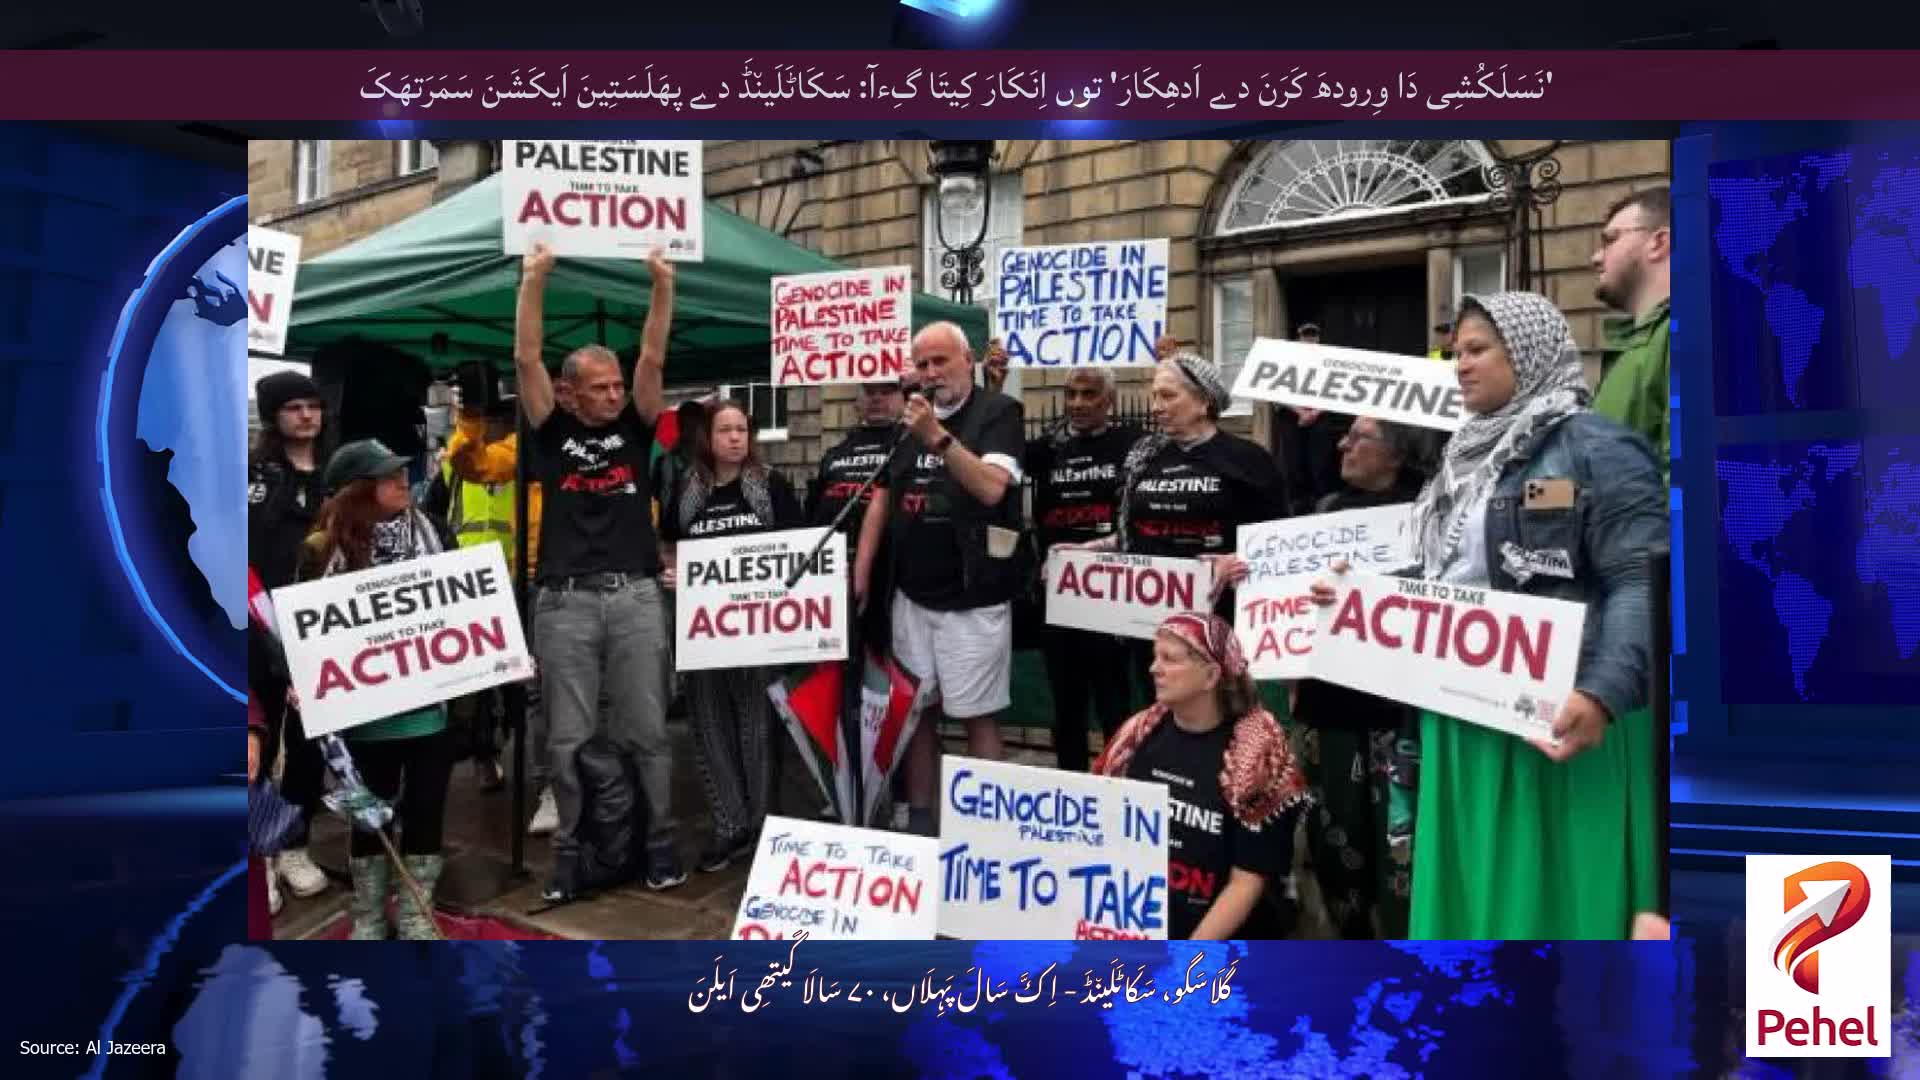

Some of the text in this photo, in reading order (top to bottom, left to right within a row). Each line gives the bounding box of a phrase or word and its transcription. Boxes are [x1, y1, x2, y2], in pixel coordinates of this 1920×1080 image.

[514, 141, 690, 178] PALESTINE
[517, 189, 687, 231] ACTION
[1002, 245, 1146, 274] GENOCIDE IN
[776, 274, 905, 306] GENOCIDE IN
[999, 265, 1166, 308] PALESTINE
[775, 298, 896, 333] PALESTINE
[998, 302, 1137, 331] TIME TO TAKE
[772, 327, 909, 356] TIME TO TAKE
[1006, 320, 1163, 366] ACTION
[780, 348, 905, 384] ACTION
[1249, 360, 1464, 419] PALESTINE
[1245, 524, 1369, 560] GENOCIDE
[355, 568, 433, 593] GENOCIDE IN
[686, 549, 835, 587] PALESTINE
[1056, 560, 1194, 611] ACTION
[293, 566, 498, 641] PALESTINE
[1397, 579, 1487, 606] TIME TO TAKE
[686, 595, 833, 640] ACTION
[1241, 593, 1313, 630] TIME
[399, 626, 415, 637] TO
[1329, 588, 1553, 682] ACTION
[314, 615, 508, 700] ACTION
[824, 841, 848, 860] TO
[863, 845, 914, 872] TAKE
[1008, 856, 1058, 912] TO
[1068, 863, 1166, 931] TAKE
[831, 908, 859, 935] IN
